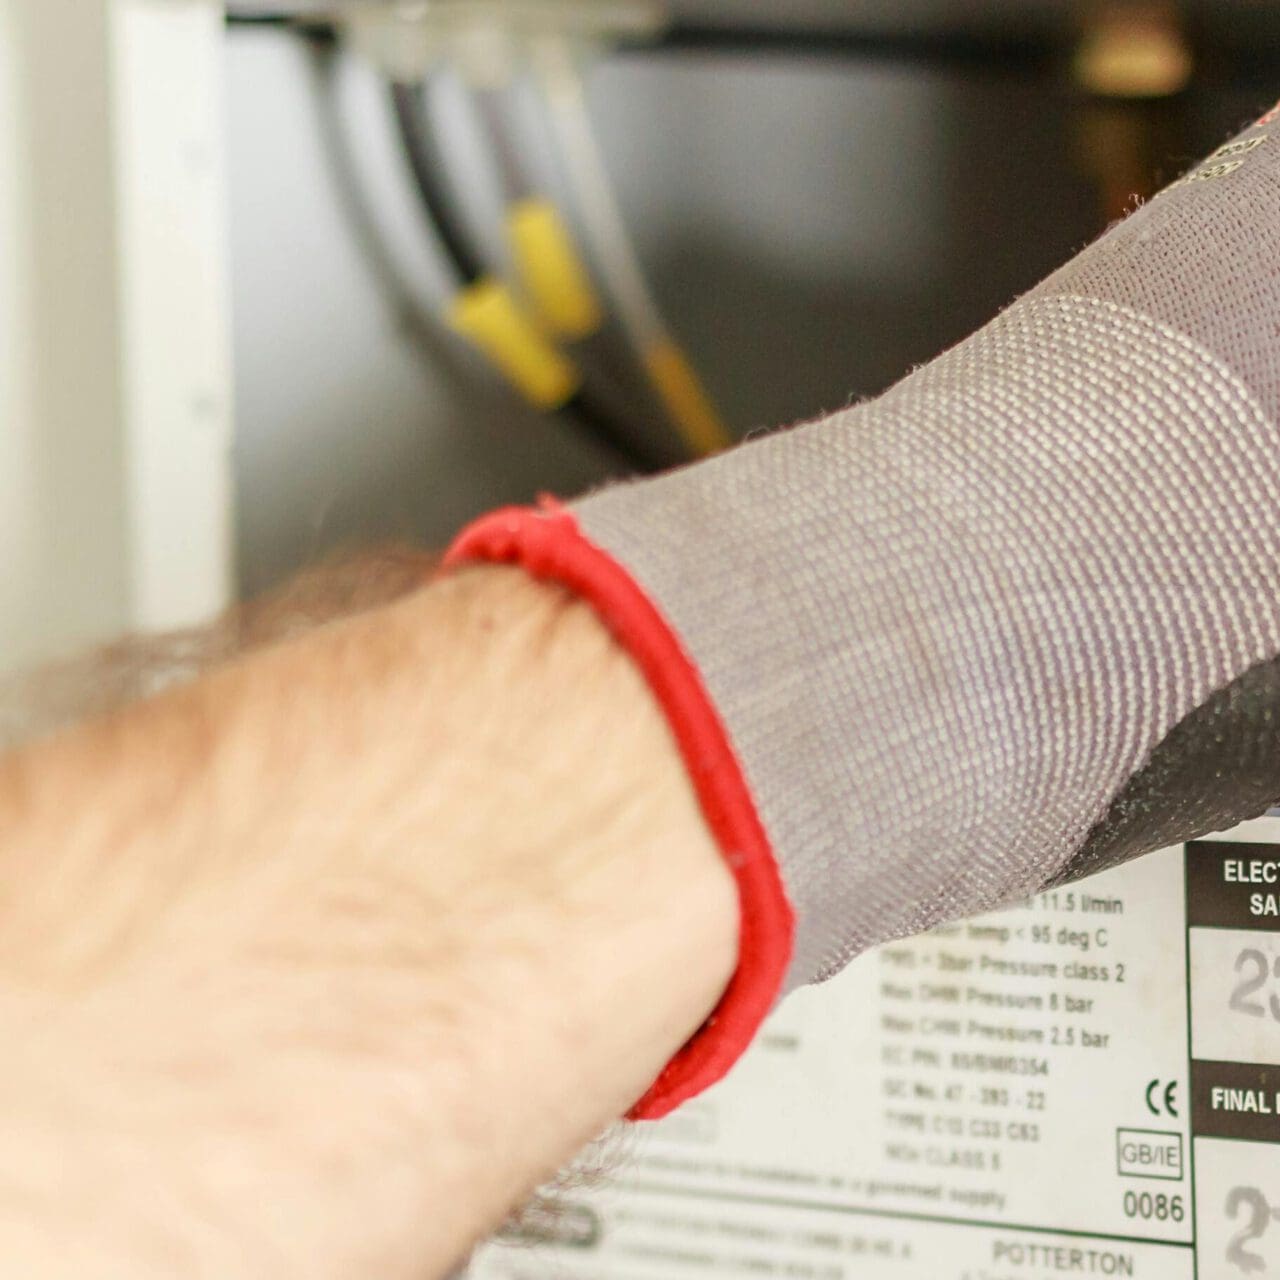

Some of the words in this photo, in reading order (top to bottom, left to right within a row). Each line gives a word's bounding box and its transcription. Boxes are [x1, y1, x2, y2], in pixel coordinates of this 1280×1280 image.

[1057, 926, 1090, 951] deg
[1095, 928, 1108, 948] C
[980, 954, 1057, 977] Pressure
[1063, 962, 1109, 982] class
[1115, 964, 1125, 983] 2
[1064, 995, 1094, 1013] bar
[1081, 1029, 1110, 1048] bar
[1211, 1087, 1271, 1114] FINAL
[1120, 1143, 1179, 1168] GB/IE
[1122, 1190, 1185, 1222] 0086
[992, 1240, 1134, 1277] POTTERTON
